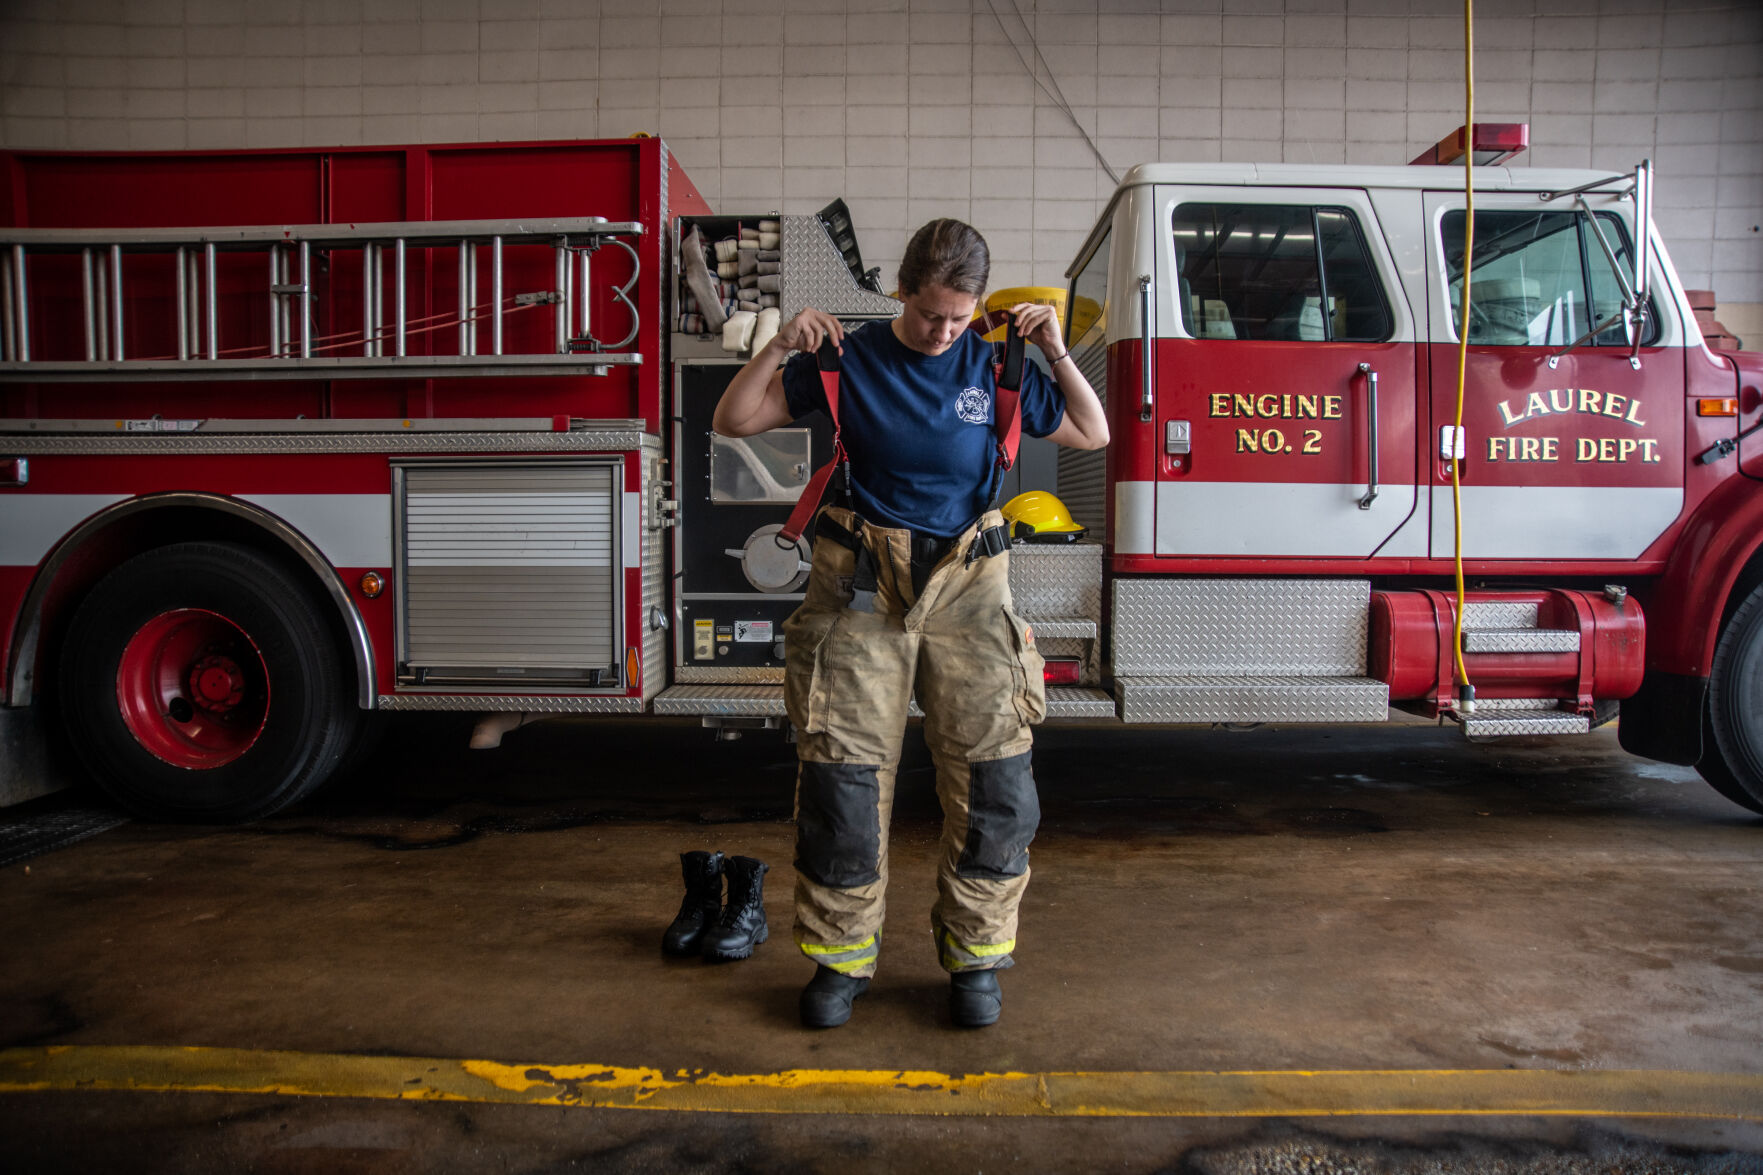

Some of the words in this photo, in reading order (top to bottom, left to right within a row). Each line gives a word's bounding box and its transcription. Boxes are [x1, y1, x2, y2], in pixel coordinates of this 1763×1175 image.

[1209, 393, 1343, 419] ENGINE
[1498, 388, 1647, 427] LAUREL
[1236, 429, 1292, 454] NO.
[1302, 429, 1323, 455] 2
[1487, 437, 1559, 462] FIRE
[1576, 438, 1661, 463] DEPT.
